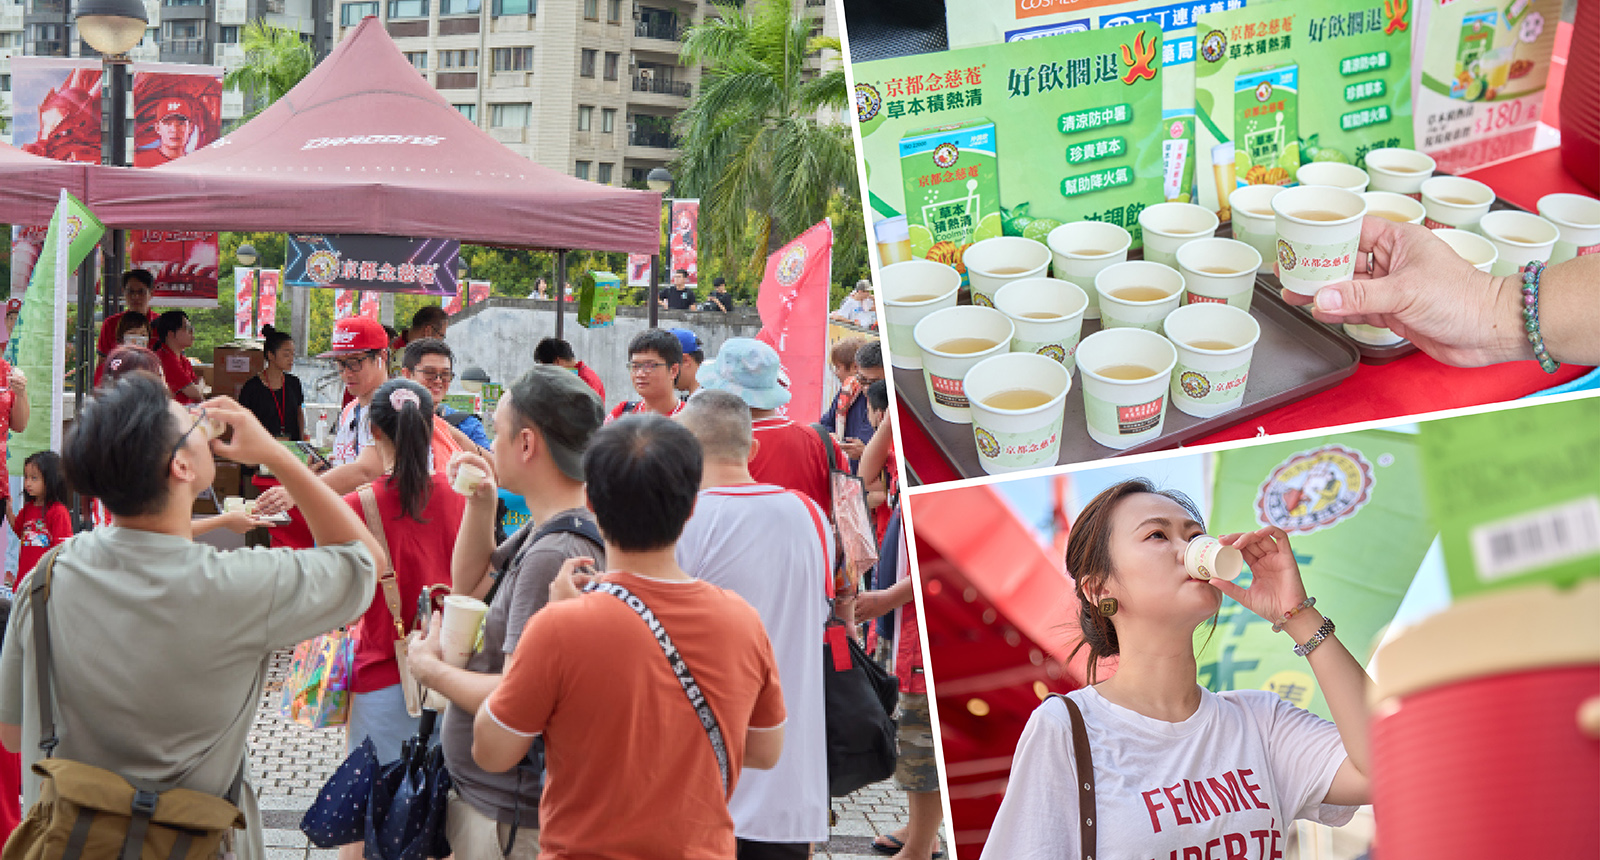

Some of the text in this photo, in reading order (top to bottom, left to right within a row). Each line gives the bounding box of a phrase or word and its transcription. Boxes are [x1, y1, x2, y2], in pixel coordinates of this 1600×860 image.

[1229, 34, 1291, 60] 草本積熱清
[886, 88, 983, 119] 草本積熱清
[1062, 105, 1127, 132] 清涼防中暑
[1069, 138, 1121, 162] 珍貴草本
[1064, 168, 1128, 195] 幫助降火氣
[933, 214, 973, 234] 積熱清
[939, 204, 965, 219] 草本
[935, 227, 974, 241] Coolmate
[1141, 768, 1271, 833] FEMME
